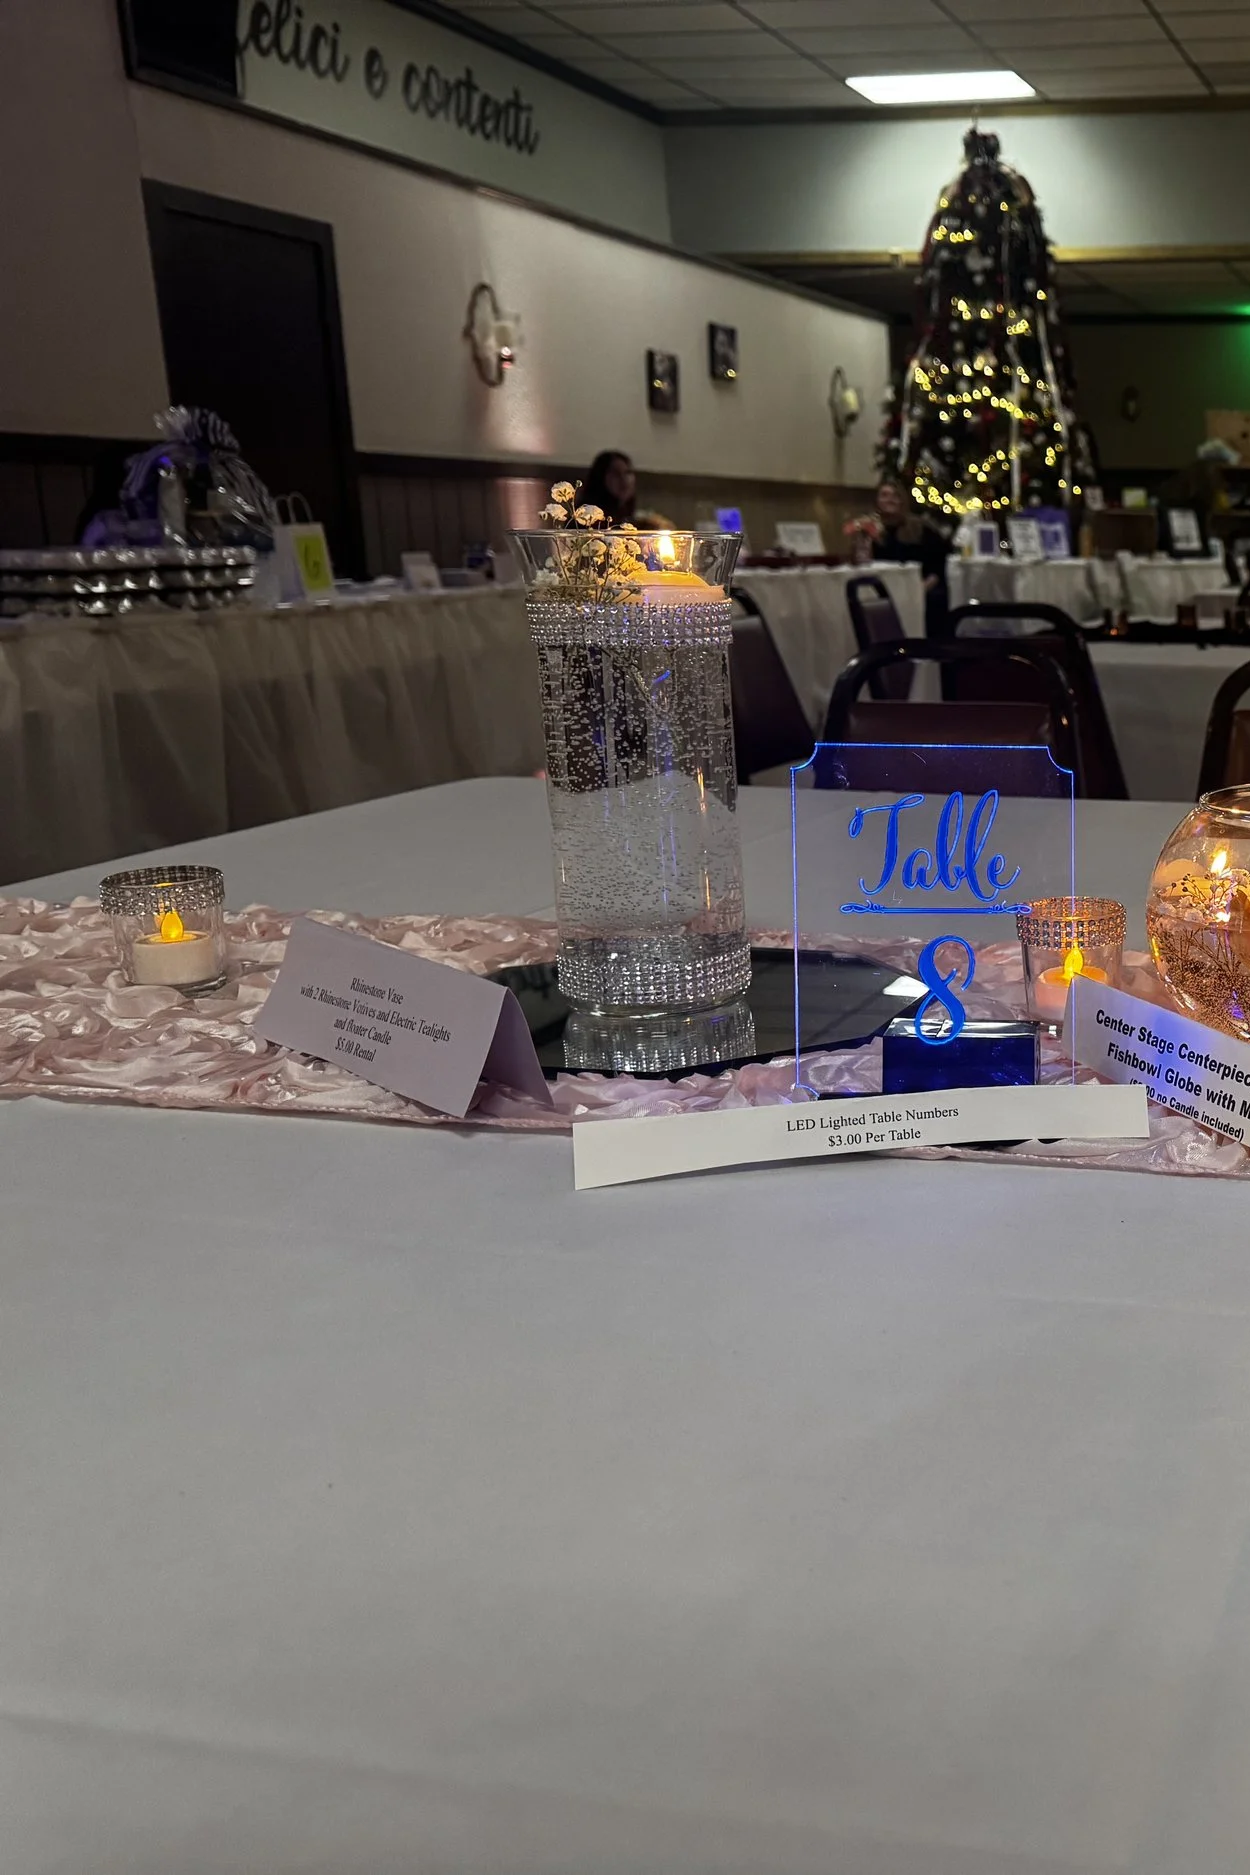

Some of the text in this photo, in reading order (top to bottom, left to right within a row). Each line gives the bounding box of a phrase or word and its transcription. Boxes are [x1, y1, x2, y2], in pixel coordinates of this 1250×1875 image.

[363, 46, 389, 100] e
[401, 62, 539, 156] contenti
[848, 789, 1021, 902] Table
[300, 984, 314, 999] with
[318, 989, 352, 1010] Rhinestone
[352, 999, 376, 1018] Votives
[376, 1010, 391, 1023] and
[390, 1011, 417, 1031] Electric
[418, 1019, 451, 1042] Tealights
[350, 977, 404, 1005] Rhinestone Vase
[914, 934, 976, 1046] 8
[334, 1018, 348, 1030] and
[367, 1026, 392, 1045] Candle
[353, 1043, 377, 1062] Rental
[1095, 1009, 1136, 1037] Center
[1137, 1026, 1174, 1055] Stage
[1107, 1041, 1161, 1079] Fishbowl
[1164, 1070, 1202, 1097] Globe
[1206, 1084, 1236, 1112] with
[787, 1107, 959, 1132] LED Lighted Table Numbers
[828, 1128, 921, 1147] $3.00 Per Table
[1156, 1093, 1167, 1104] no
[1169, 1097, 1200, 1119] Candle
[1201, 1111, 1245, 1142] included)
